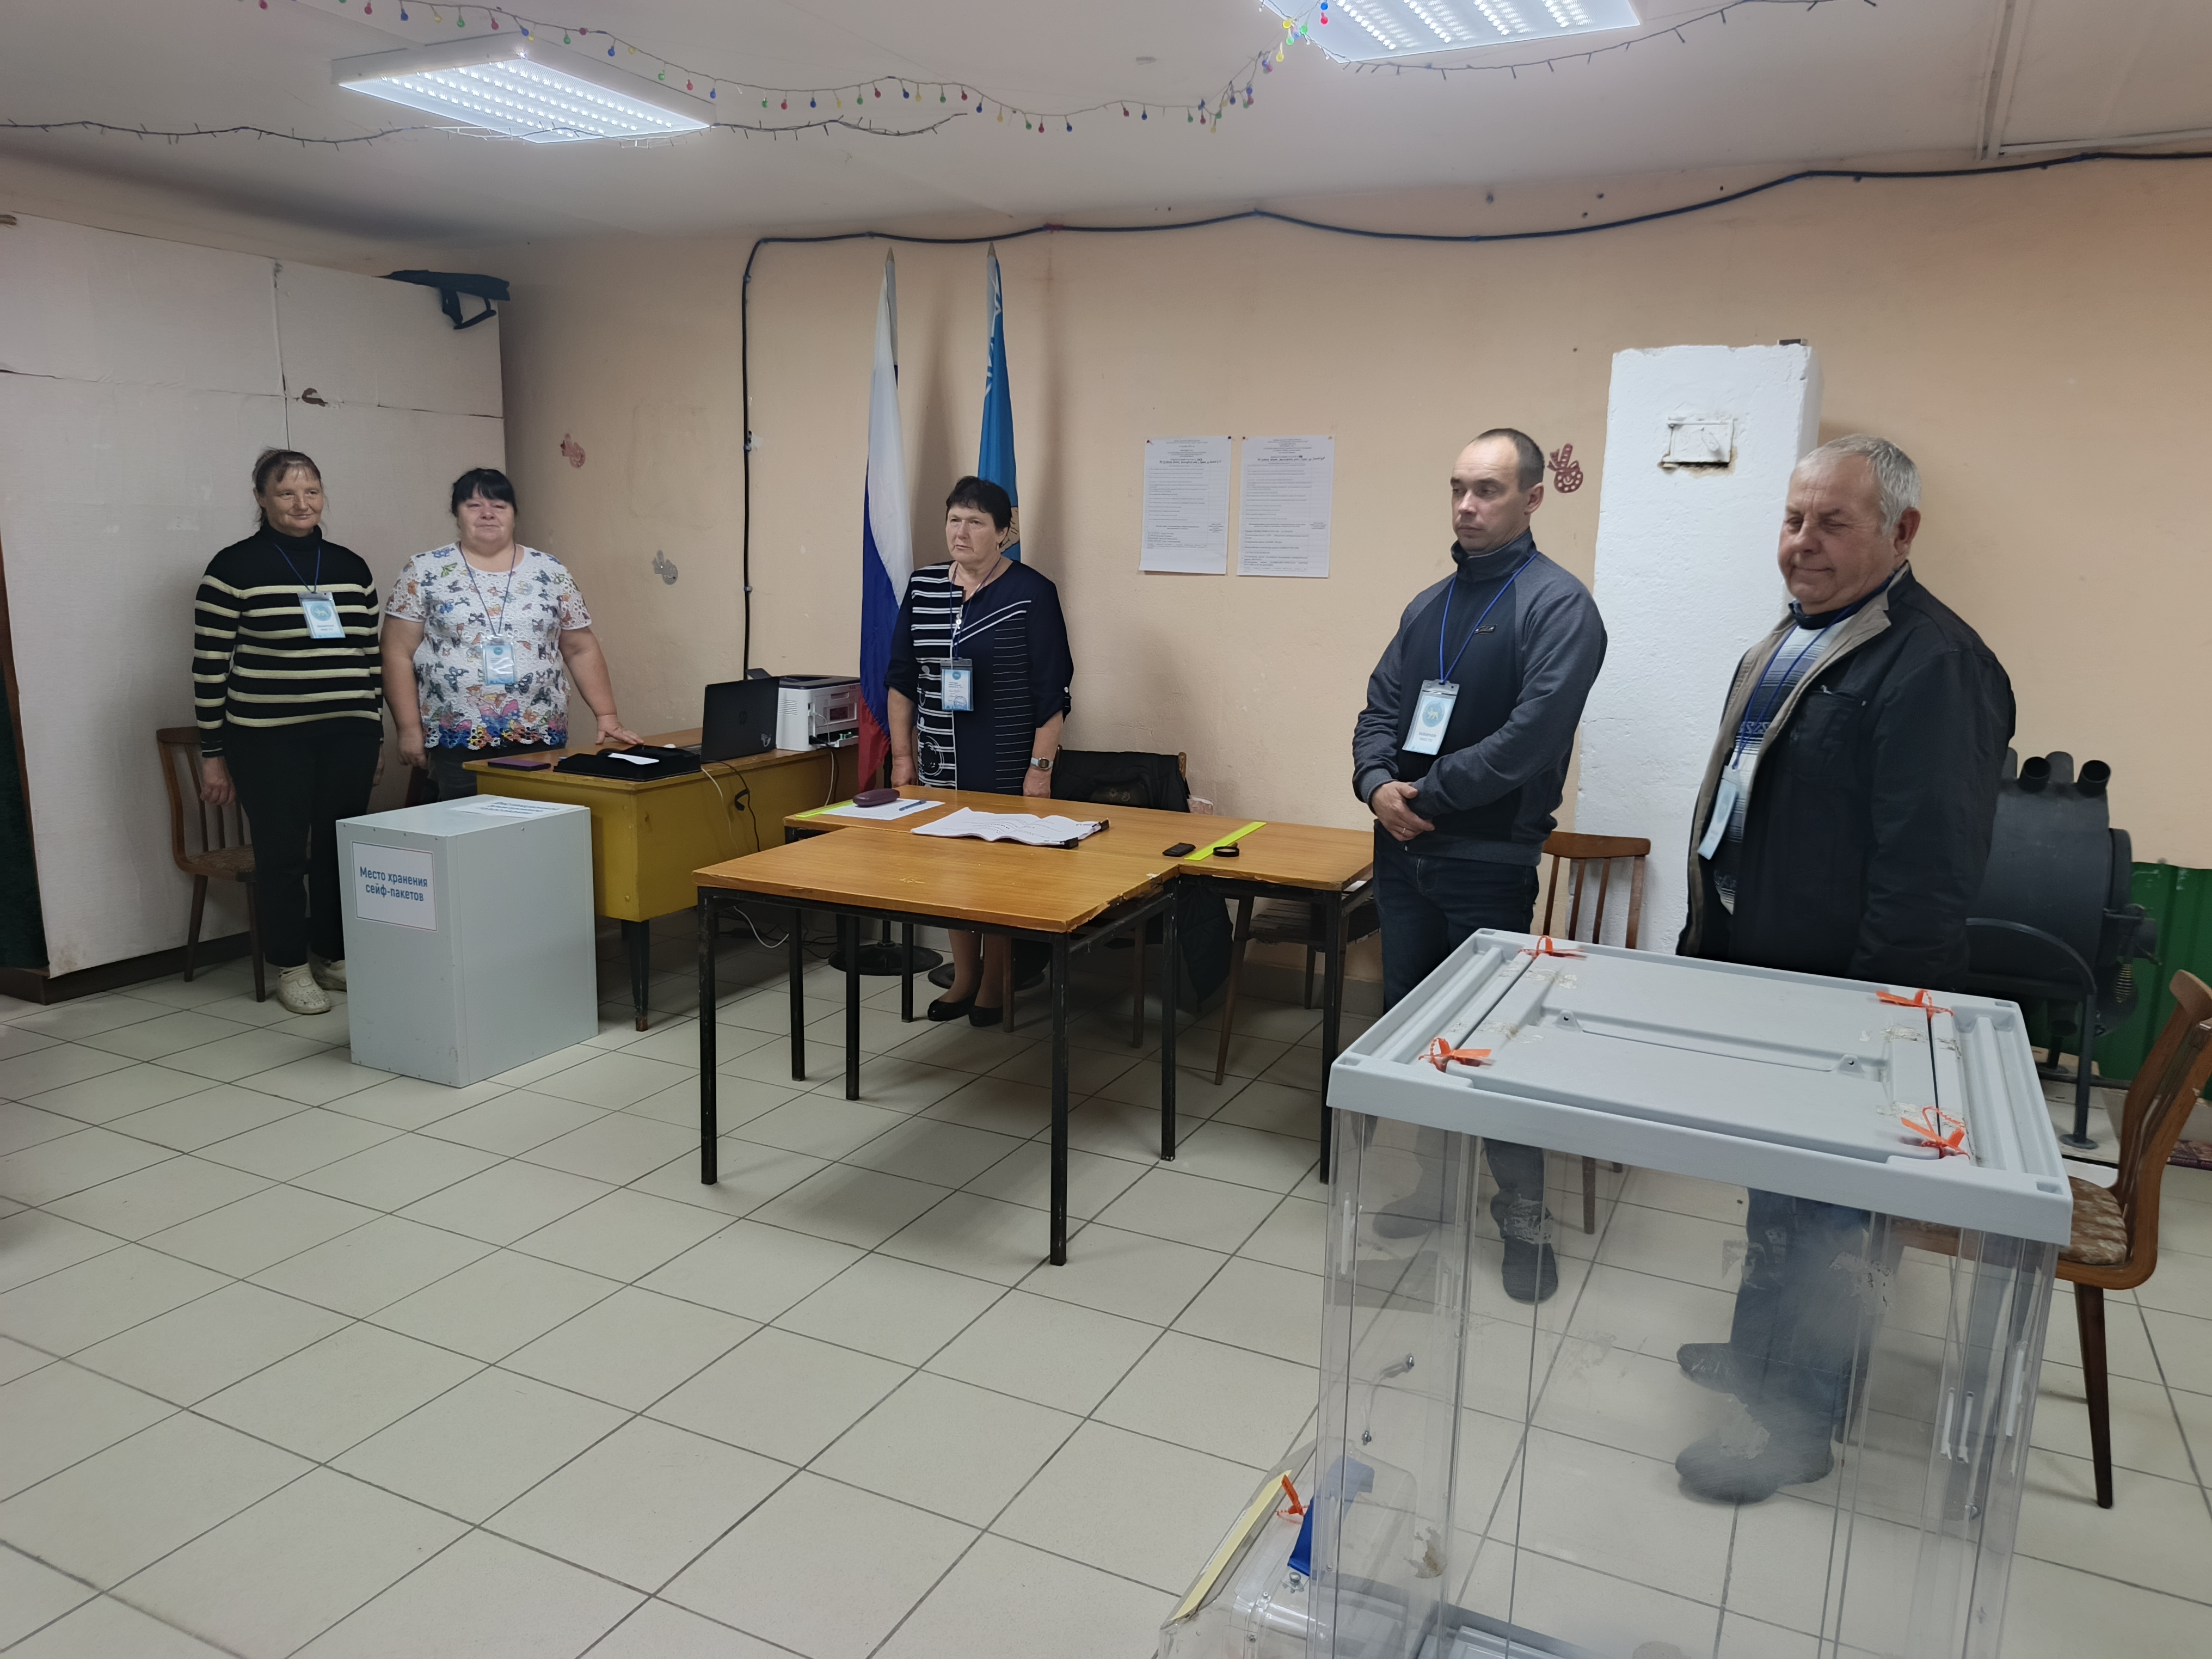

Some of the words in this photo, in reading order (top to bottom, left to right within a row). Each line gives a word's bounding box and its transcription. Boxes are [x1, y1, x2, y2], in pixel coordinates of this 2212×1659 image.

[360, 867, 386, 881] Место
[388, 873, 428, 887] хранения
[365, 883, 424, 901] сейф-пакетов
